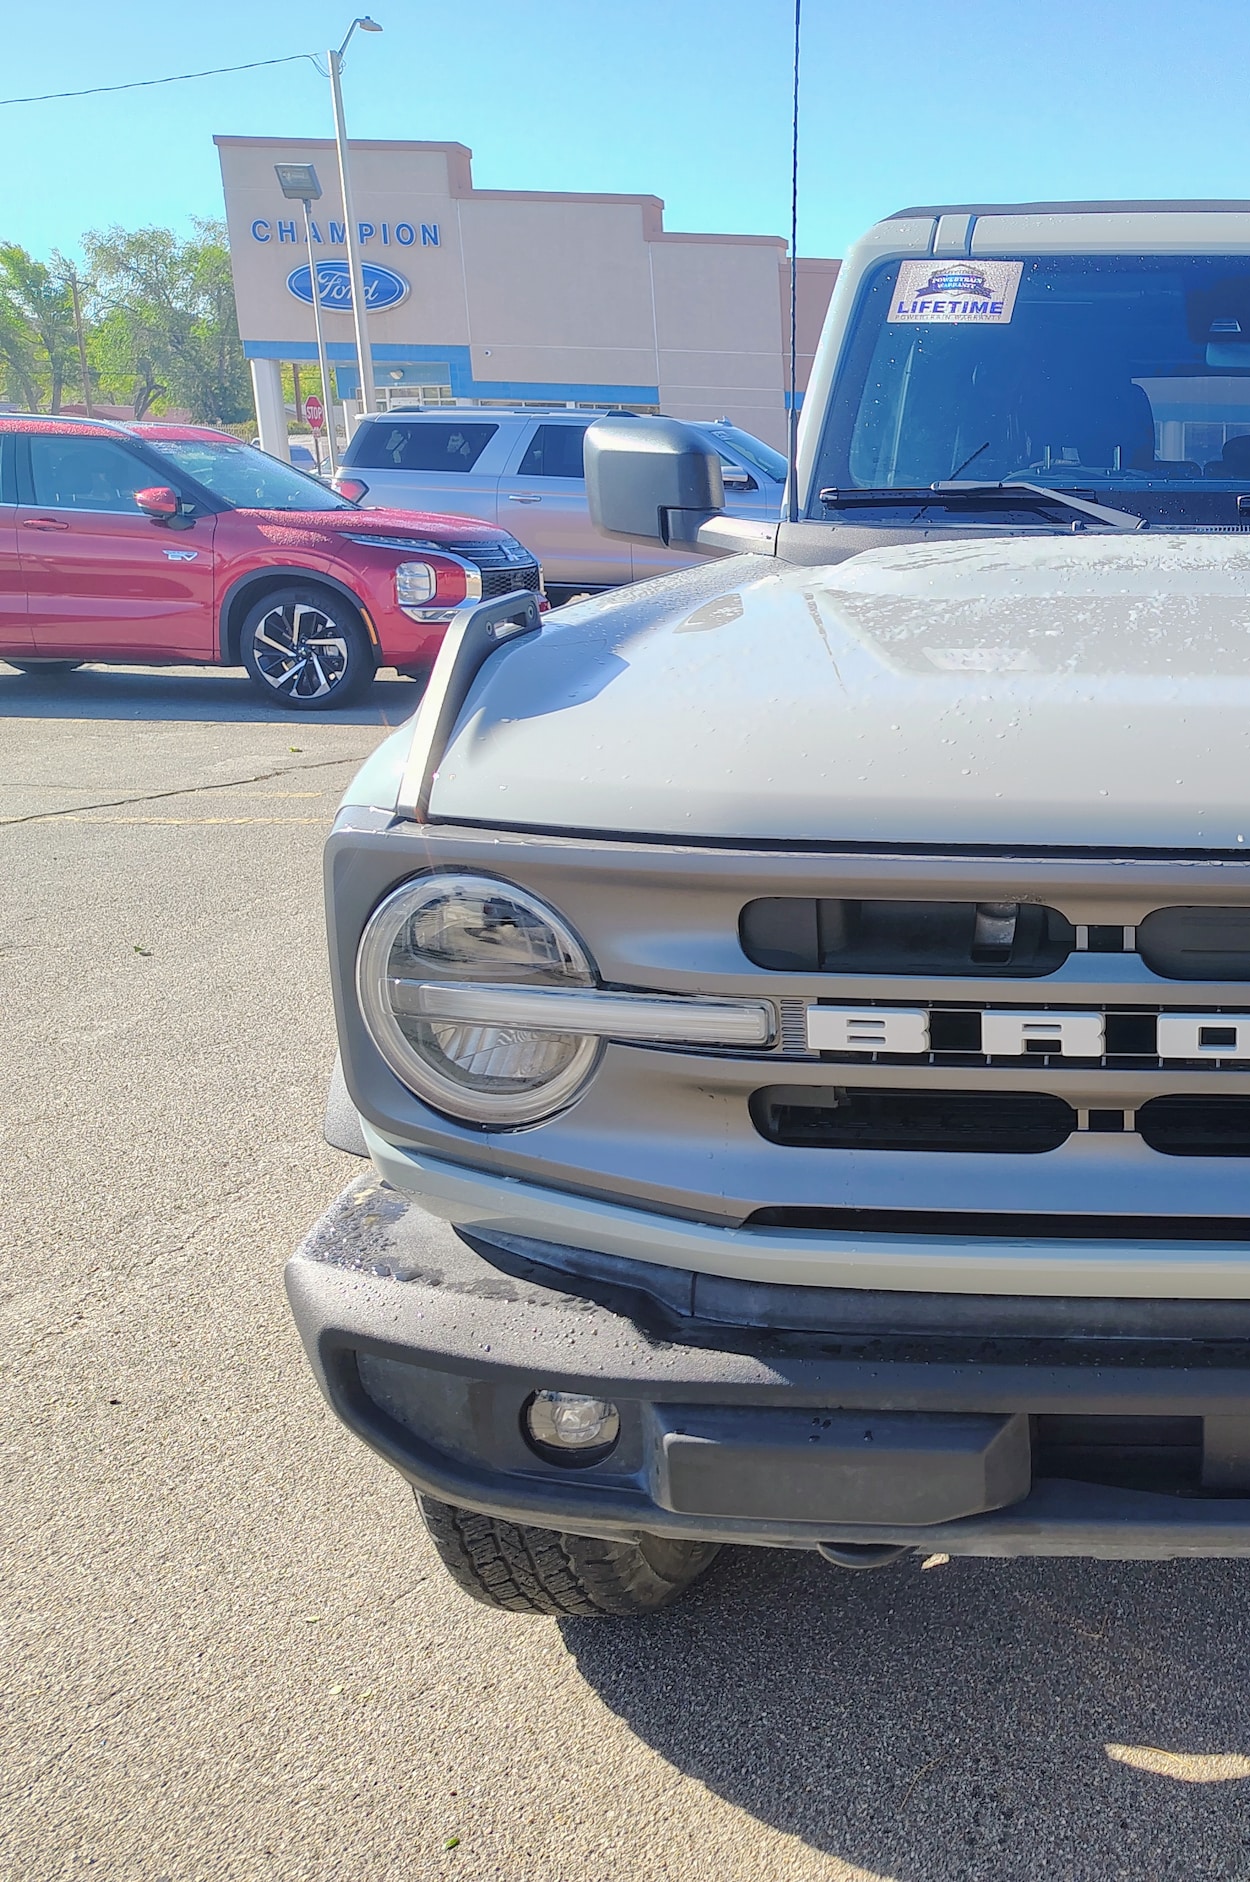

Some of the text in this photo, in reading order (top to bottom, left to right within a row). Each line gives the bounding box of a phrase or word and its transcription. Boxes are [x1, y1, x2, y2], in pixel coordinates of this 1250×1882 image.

[251, 219, 440, 247] CHAMPION
[897, 301, 1004, 315] LIFETIME
[306, 406, 322, 420] STOP
